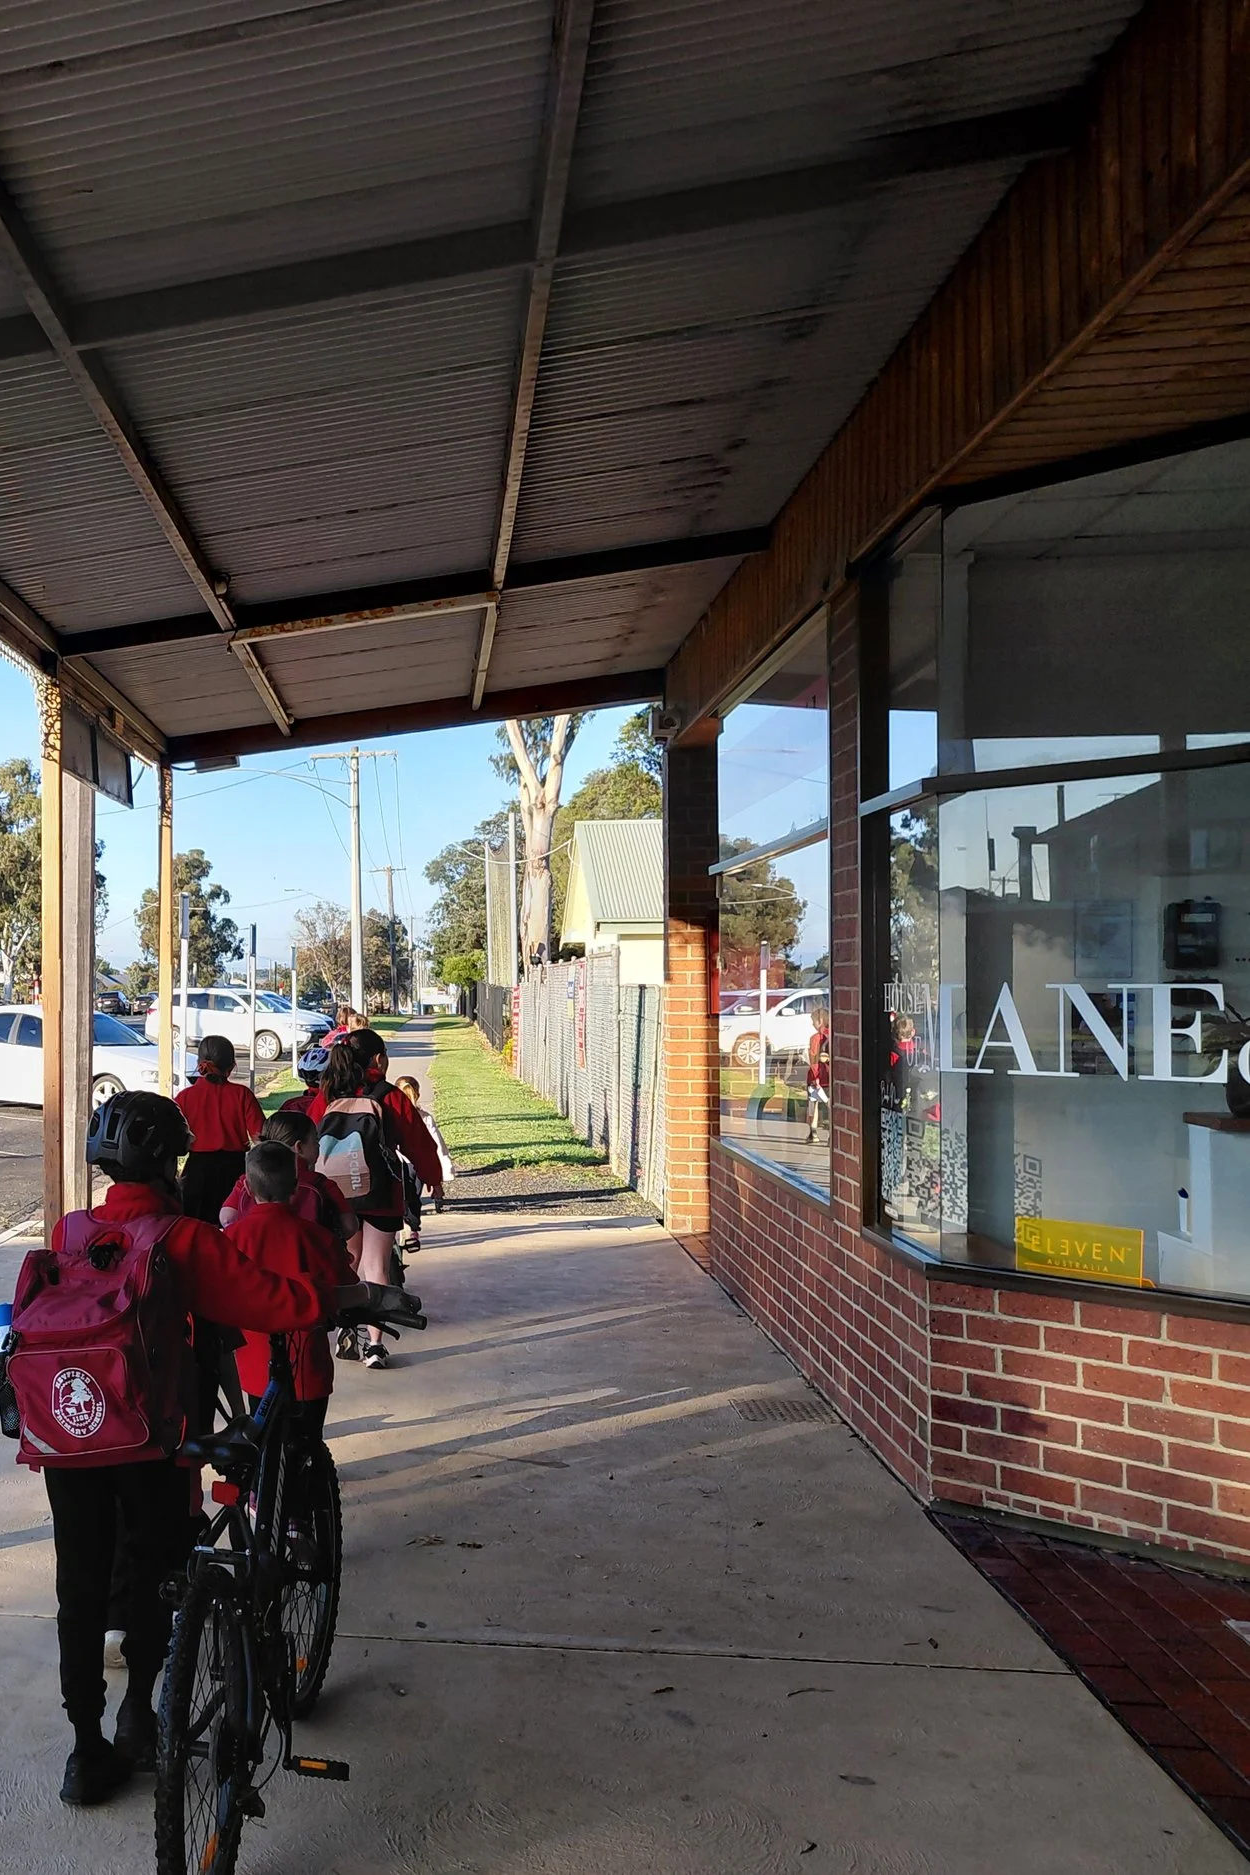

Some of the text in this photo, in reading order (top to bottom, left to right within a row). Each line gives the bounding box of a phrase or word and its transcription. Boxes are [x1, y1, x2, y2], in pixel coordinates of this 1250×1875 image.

[883, 983, 925, 1015] HOUSE
[919, 982, 1229, 1084] MANE
[1047, 1258, 1109, 1273] AUSTRALIA
[55, 1371, 91, 1389] HEYFIELD
[55, 1401, 103, 1435] PRIMARY SCHOOL
